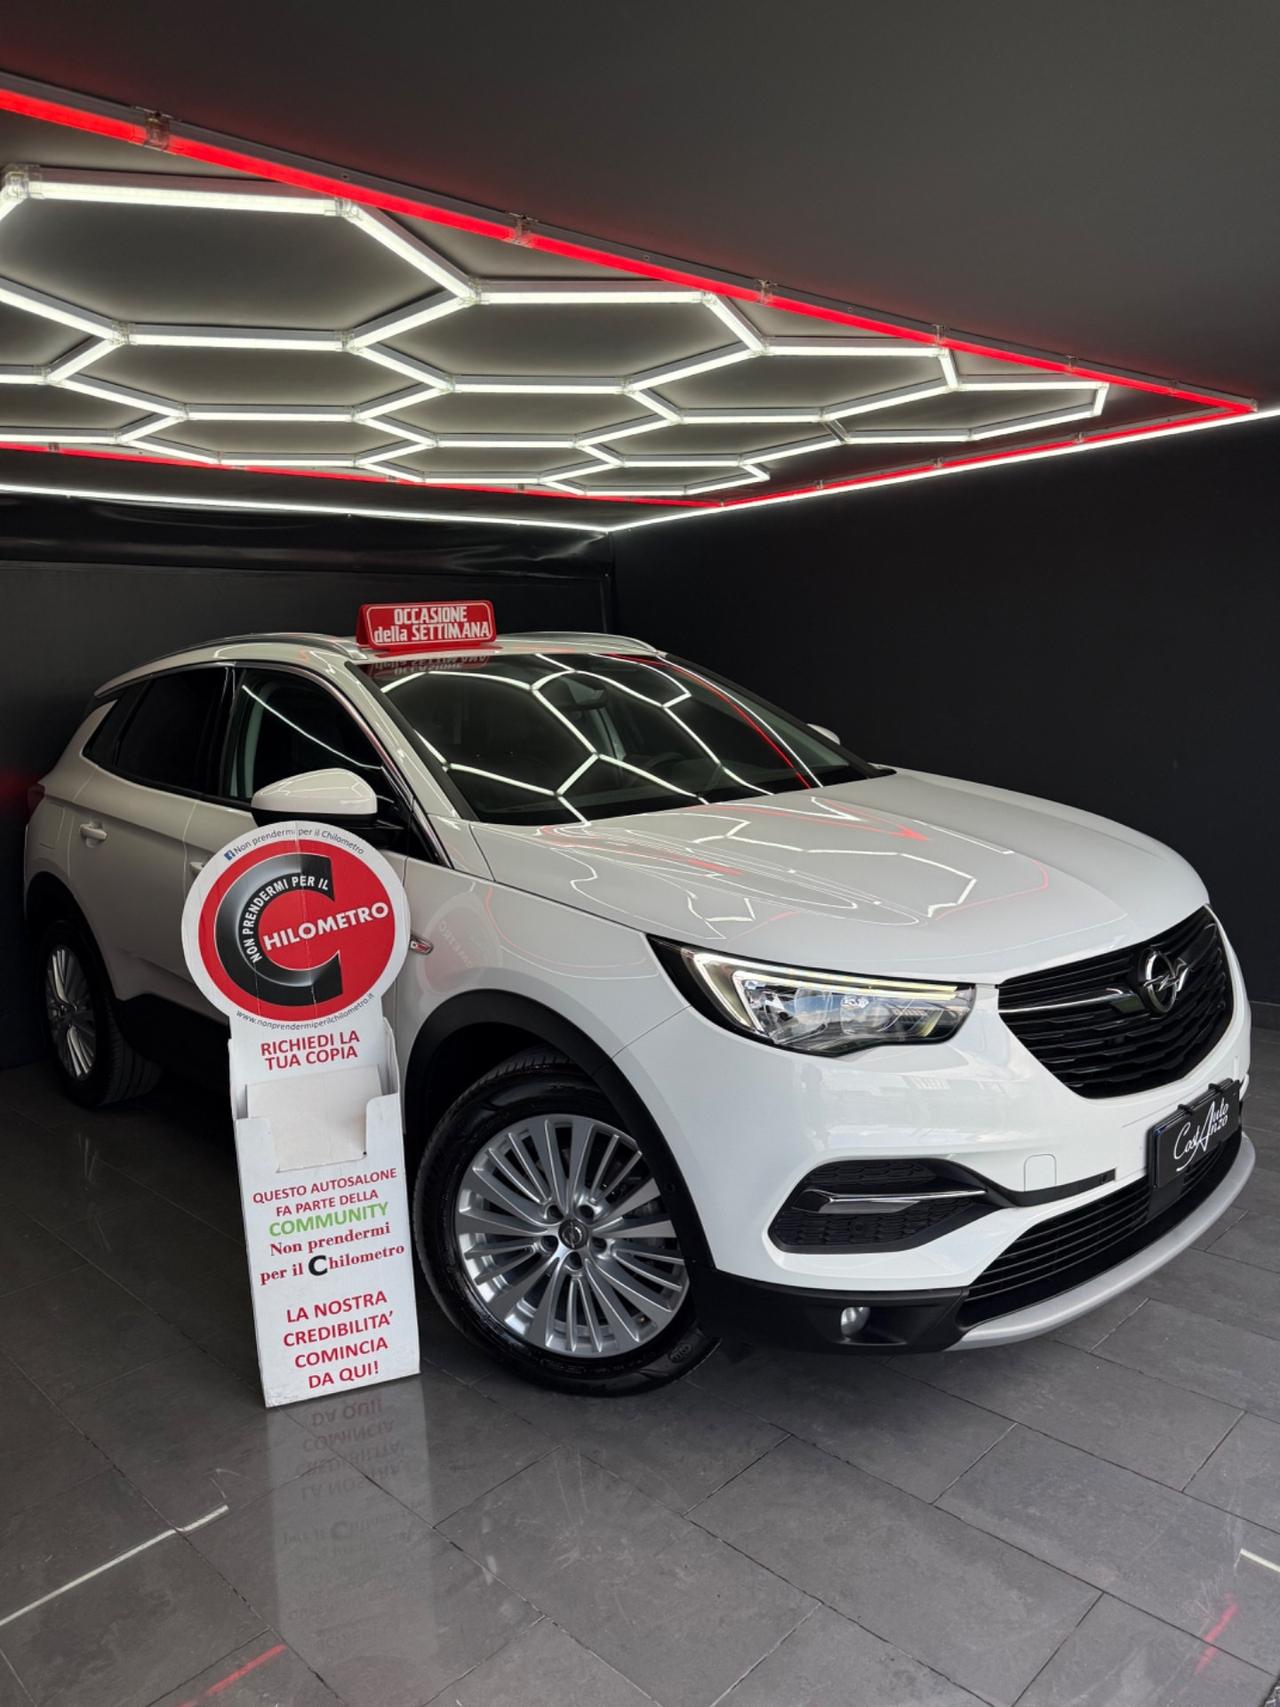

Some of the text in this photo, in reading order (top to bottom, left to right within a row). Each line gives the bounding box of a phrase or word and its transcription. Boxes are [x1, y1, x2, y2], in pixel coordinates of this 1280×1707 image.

[394, 606, 468, 624] OCCASIONE
[374, 621, 490, 643] della SETTIMANA
[233, 841, 251, 855] Non
[298, 828, 313, 837] per
[314, 828, 321, 837] il
[321, 830, 365, 855] Chilometro
[242, 875, 329, 963] NON PRENDERMI PER IL
[236, 993, 375, 1031] www.nonprendermiperilchilometro.it
[260, 1030, 360, 1056] RICHIEDI LA
[265, 1046, 358, 1071] TUA COPIA
[252, 1167, 398, 1204] QUESTO AUTOSALONE
[276, 1189, 379, 1217] FA PARTE DELLA
[269, 1201, 389, 1237] COMMUNITY
[270, 1221, 391, 1257] Non prendermi
[259, 1268, 288, 1285] per
[292, 1262, 304, 1277] il
[286, 1290, 388, 1323] LA NOSTRA
[294, 1337, 389, 1369] COMINCIA
[308, 1360, 379, 1389] DA QUI!
